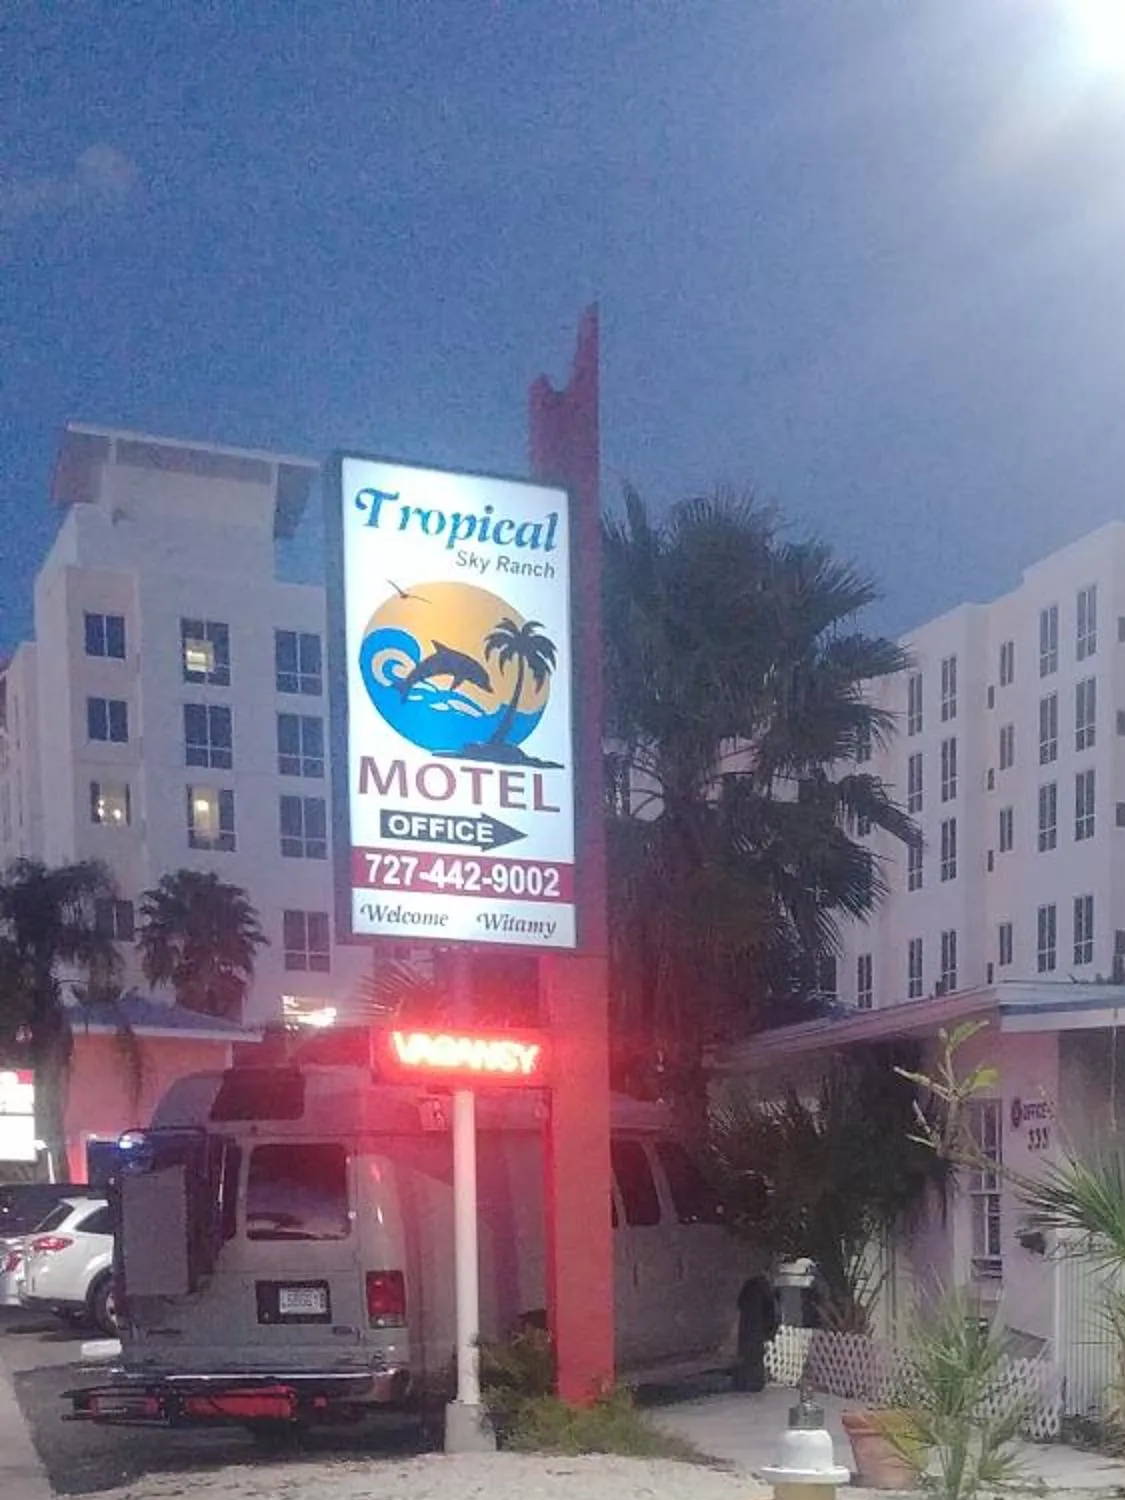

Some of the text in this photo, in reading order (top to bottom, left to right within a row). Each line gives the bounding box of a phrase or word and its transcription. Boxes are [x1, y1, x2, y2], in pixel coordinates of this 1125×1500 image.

[354, 487, 559, 552] Tropical
[456, 550, 556, 579] Sky Ranch
[358, 755, 561, 814] MOTEL
[387, 813, 495, 844] OFFICE
[365, 853, 561, 897] 727-442-9002
[359, 903, 557, 938] Welcome Witamy
